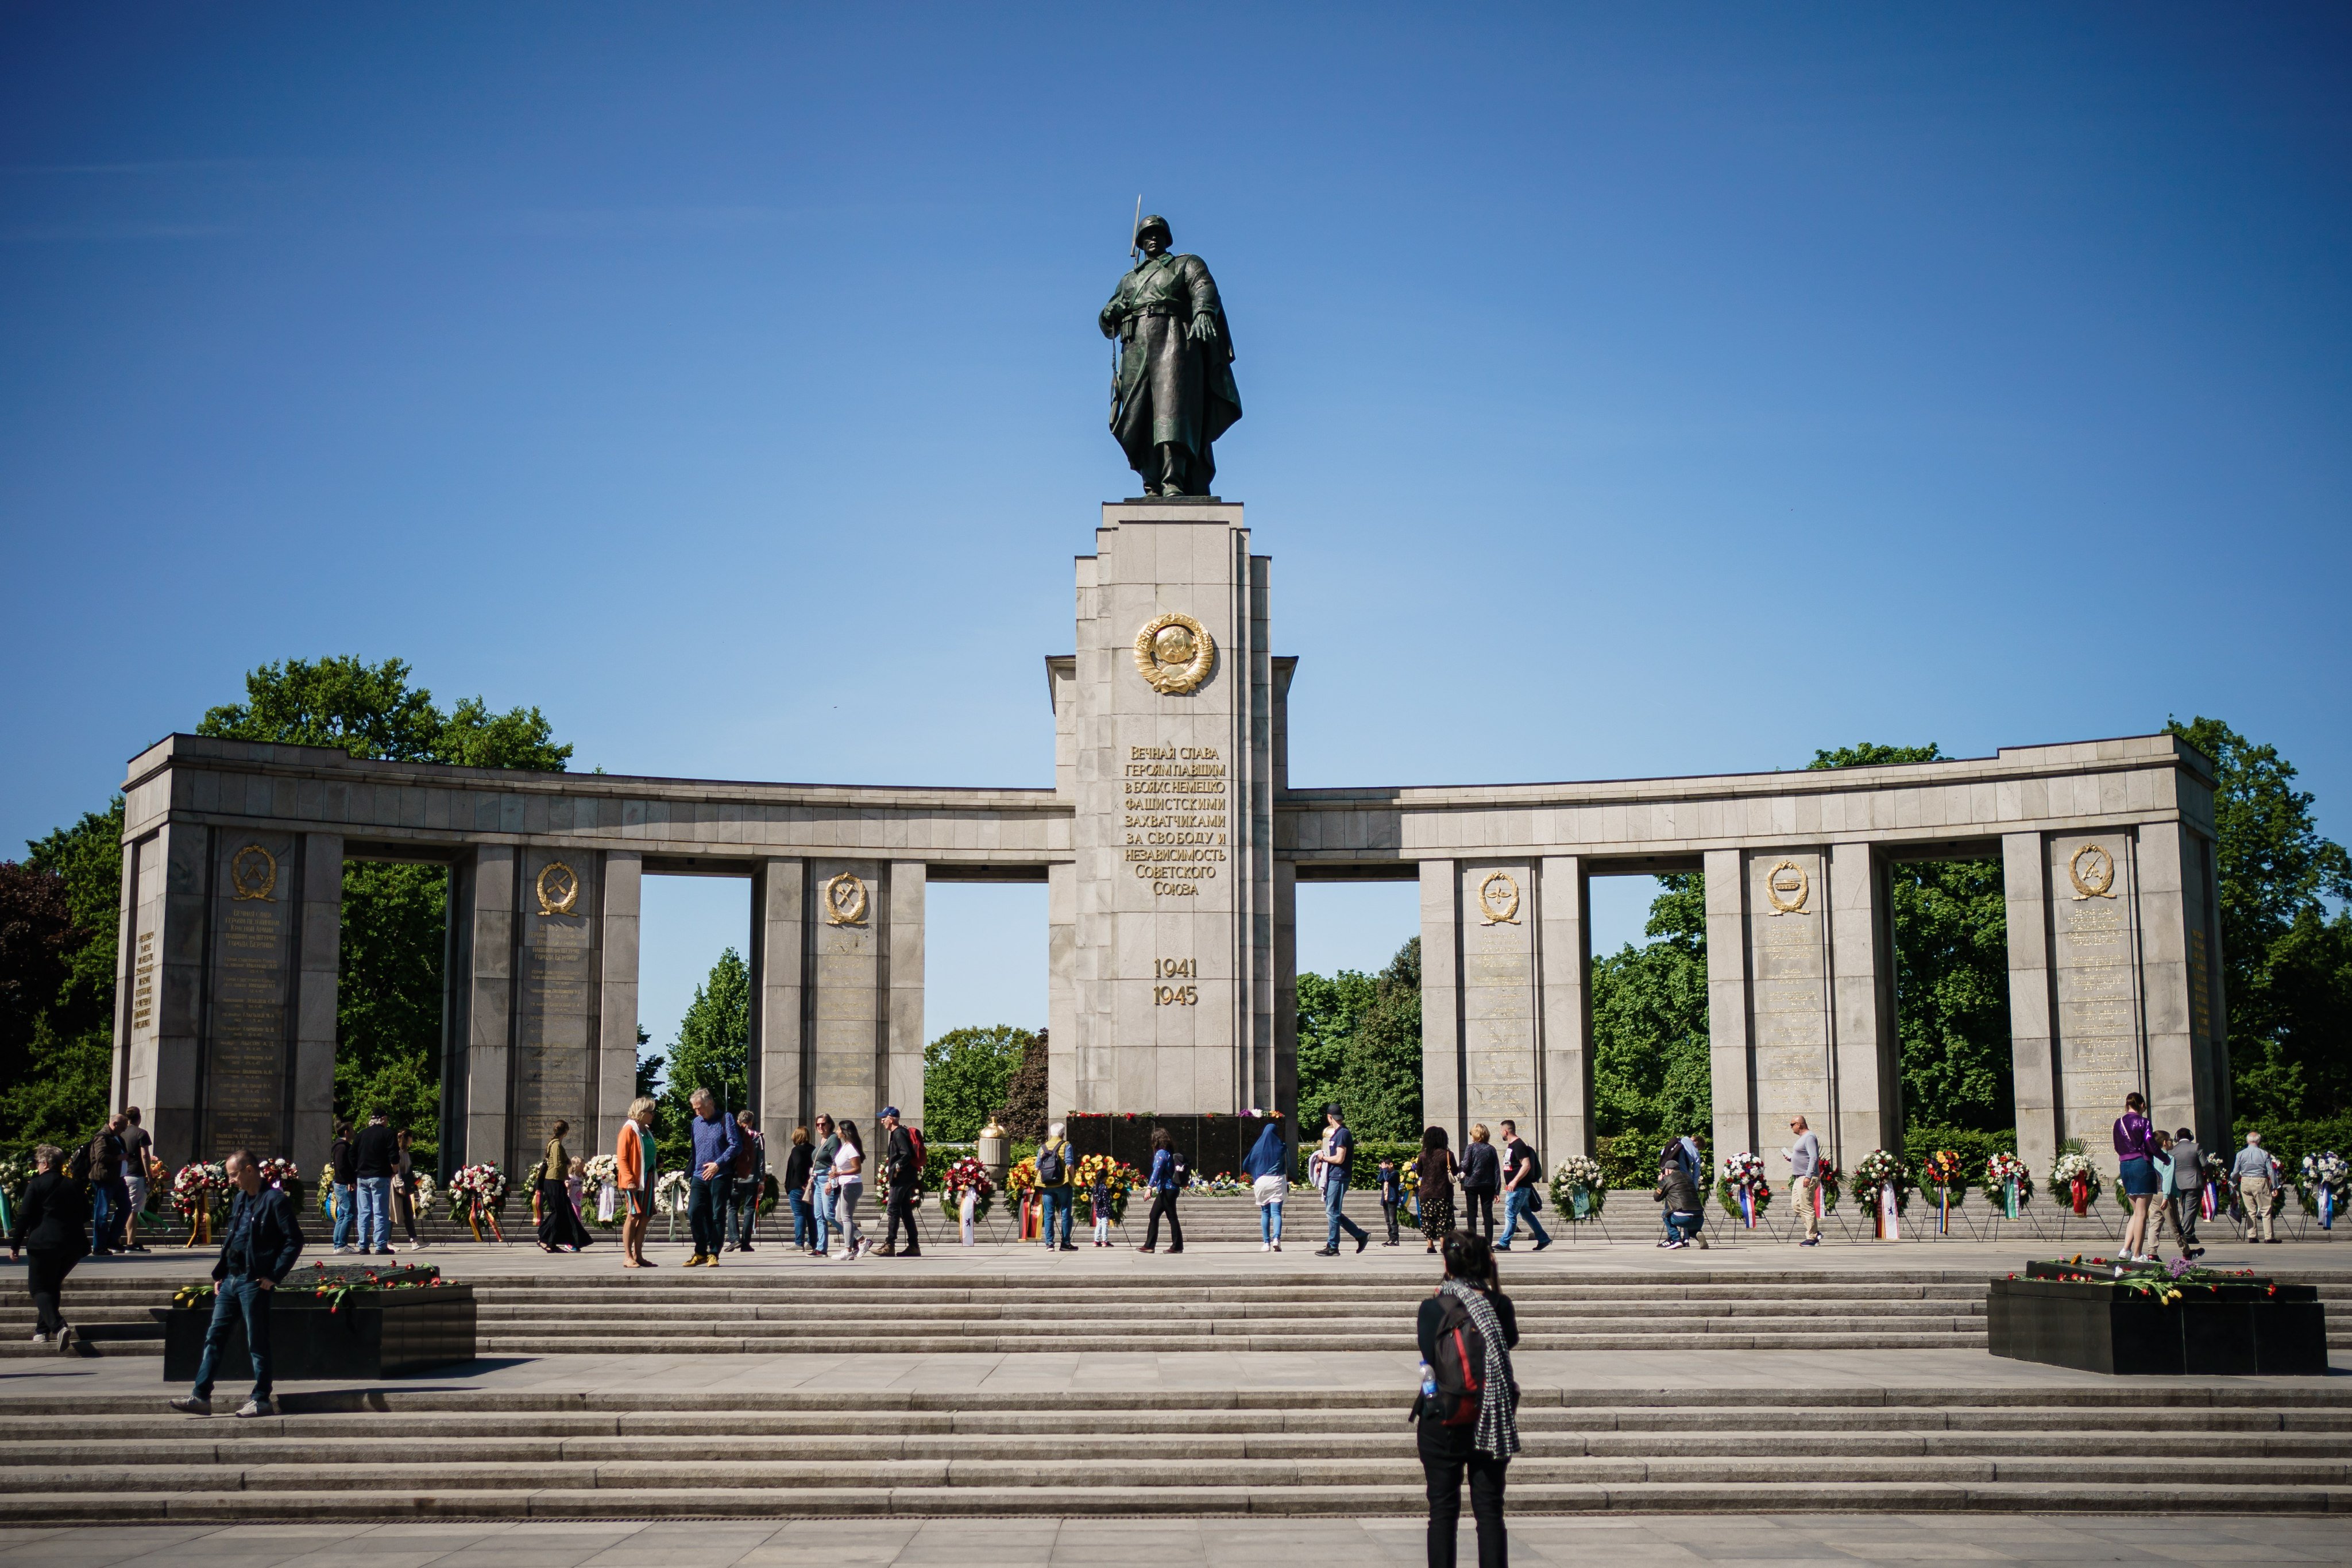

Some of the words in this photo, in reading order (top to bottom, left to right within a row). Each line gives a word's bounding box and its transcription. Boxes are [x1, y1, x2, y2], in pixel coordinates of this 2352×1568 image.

[1131, 746, 1176, 760] ВЕЧНАЯ
[1180, 747, 1219, 760] СЛАВА
[1125, 764, 1171, 777] ГЕРОЯМ
[1173, 764, 1226, 777] ПАВШИМ
[1134, 781, 1163, 793] БОЯХ
[1172, 781, 1225, 793] НЕМЕЦКО
[1125, 798, 1226, 810] ФАШИСТСКИМИ
[1125, 815, 1226, 828] ЗАХВАТЧИКАМИ
[1126, 833, 1142, 844] ЗА
[1148, 832, 1213, 845] СВОБОДУ
[1218, 832, 1226, 844] И
[1125, 849, 1226, 862] НЕЗАВИСИМОСТЬ
[1136, 864, 1215, 879] СОВЕТСКОГО
[1153, 881, 1199, 896] СОЮЗА
[1154, 958, 1196, 978] 1941
[1153, 986, 1198, 1005] 1945
